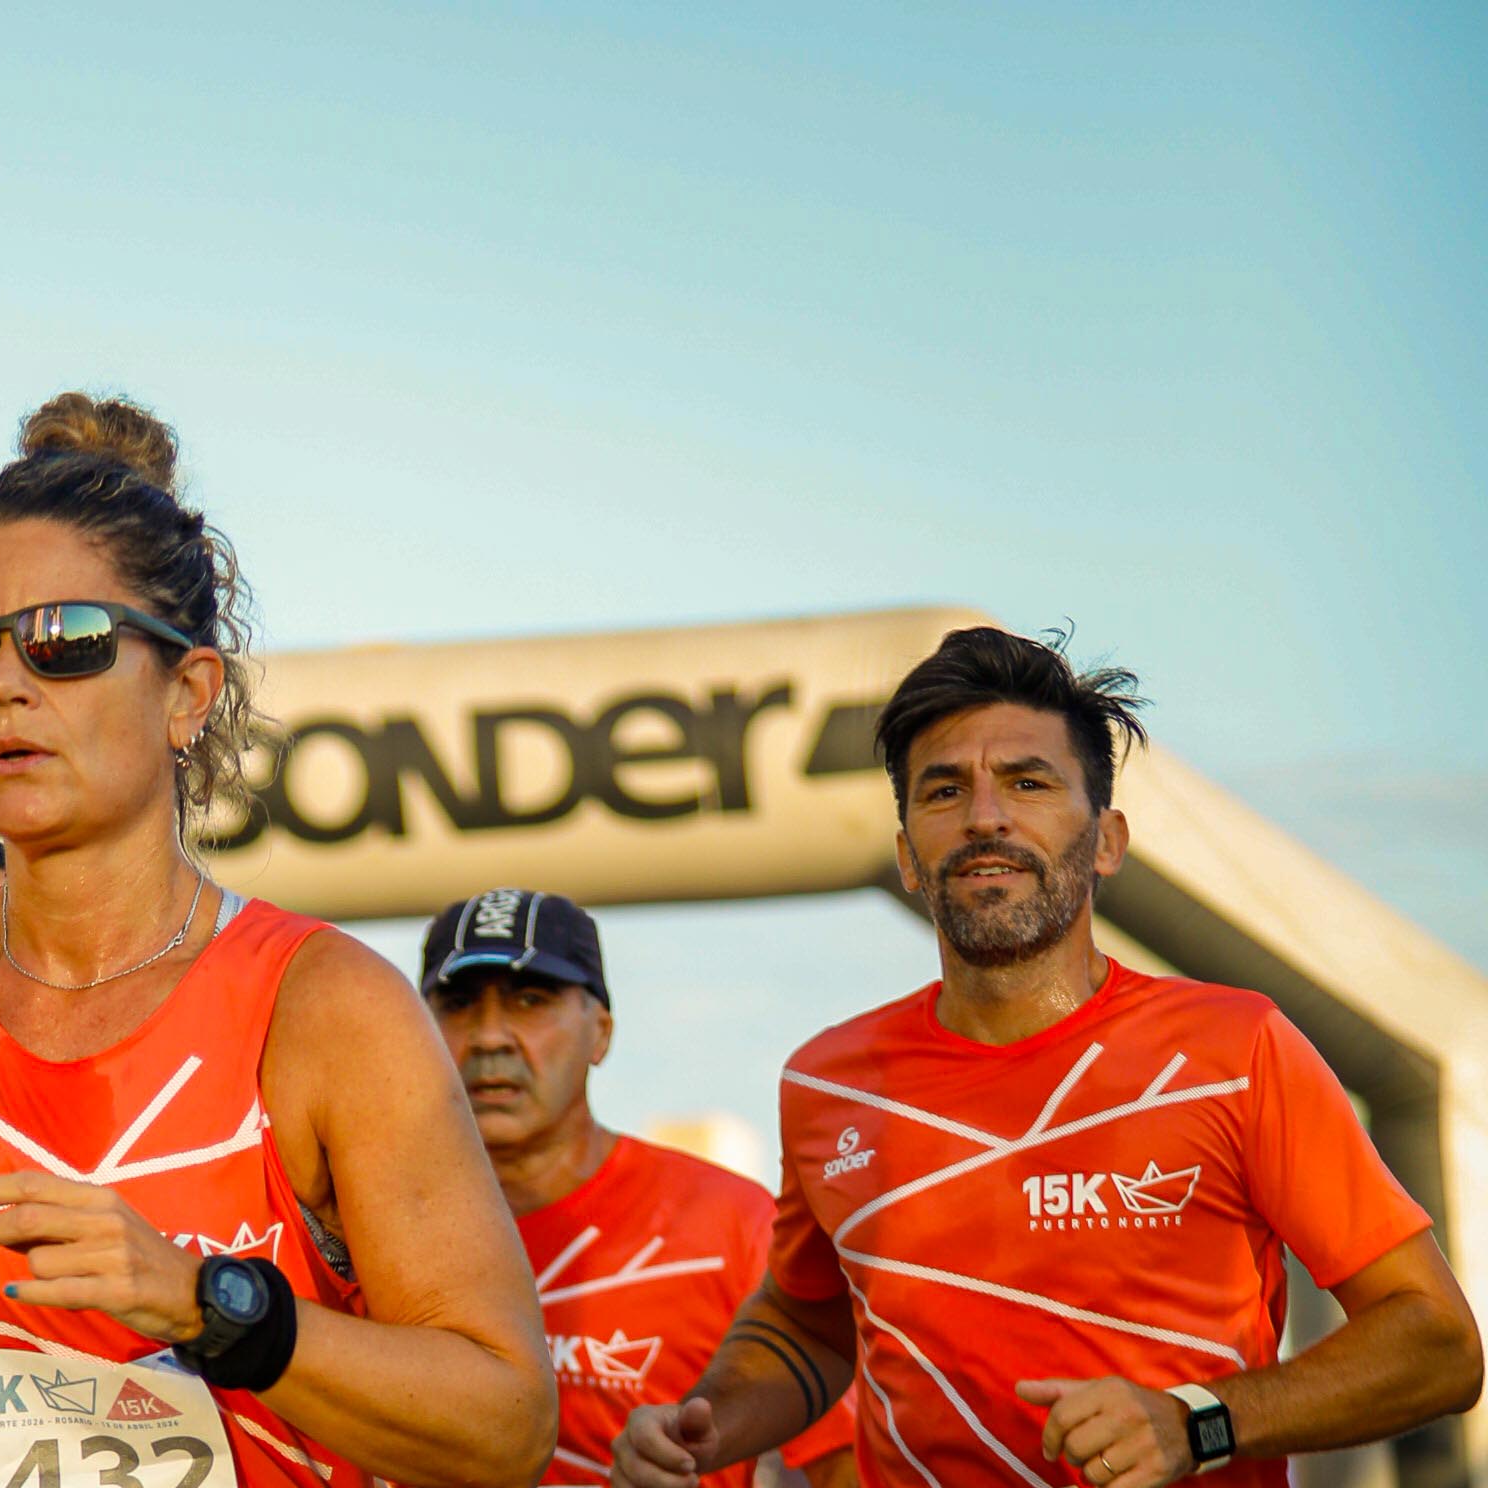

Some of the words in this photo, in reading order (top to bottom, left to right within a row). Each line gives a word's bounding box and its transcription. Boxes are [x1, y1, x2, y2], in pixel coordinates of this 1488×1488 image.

[1022, 1173, 1107, 1217] 15K
[1029, 1218, 1110, 1231] PUERTO
[1118, 1215, 1183, 1228] NORTE
[117, 1397, 160, 1417] 15K
